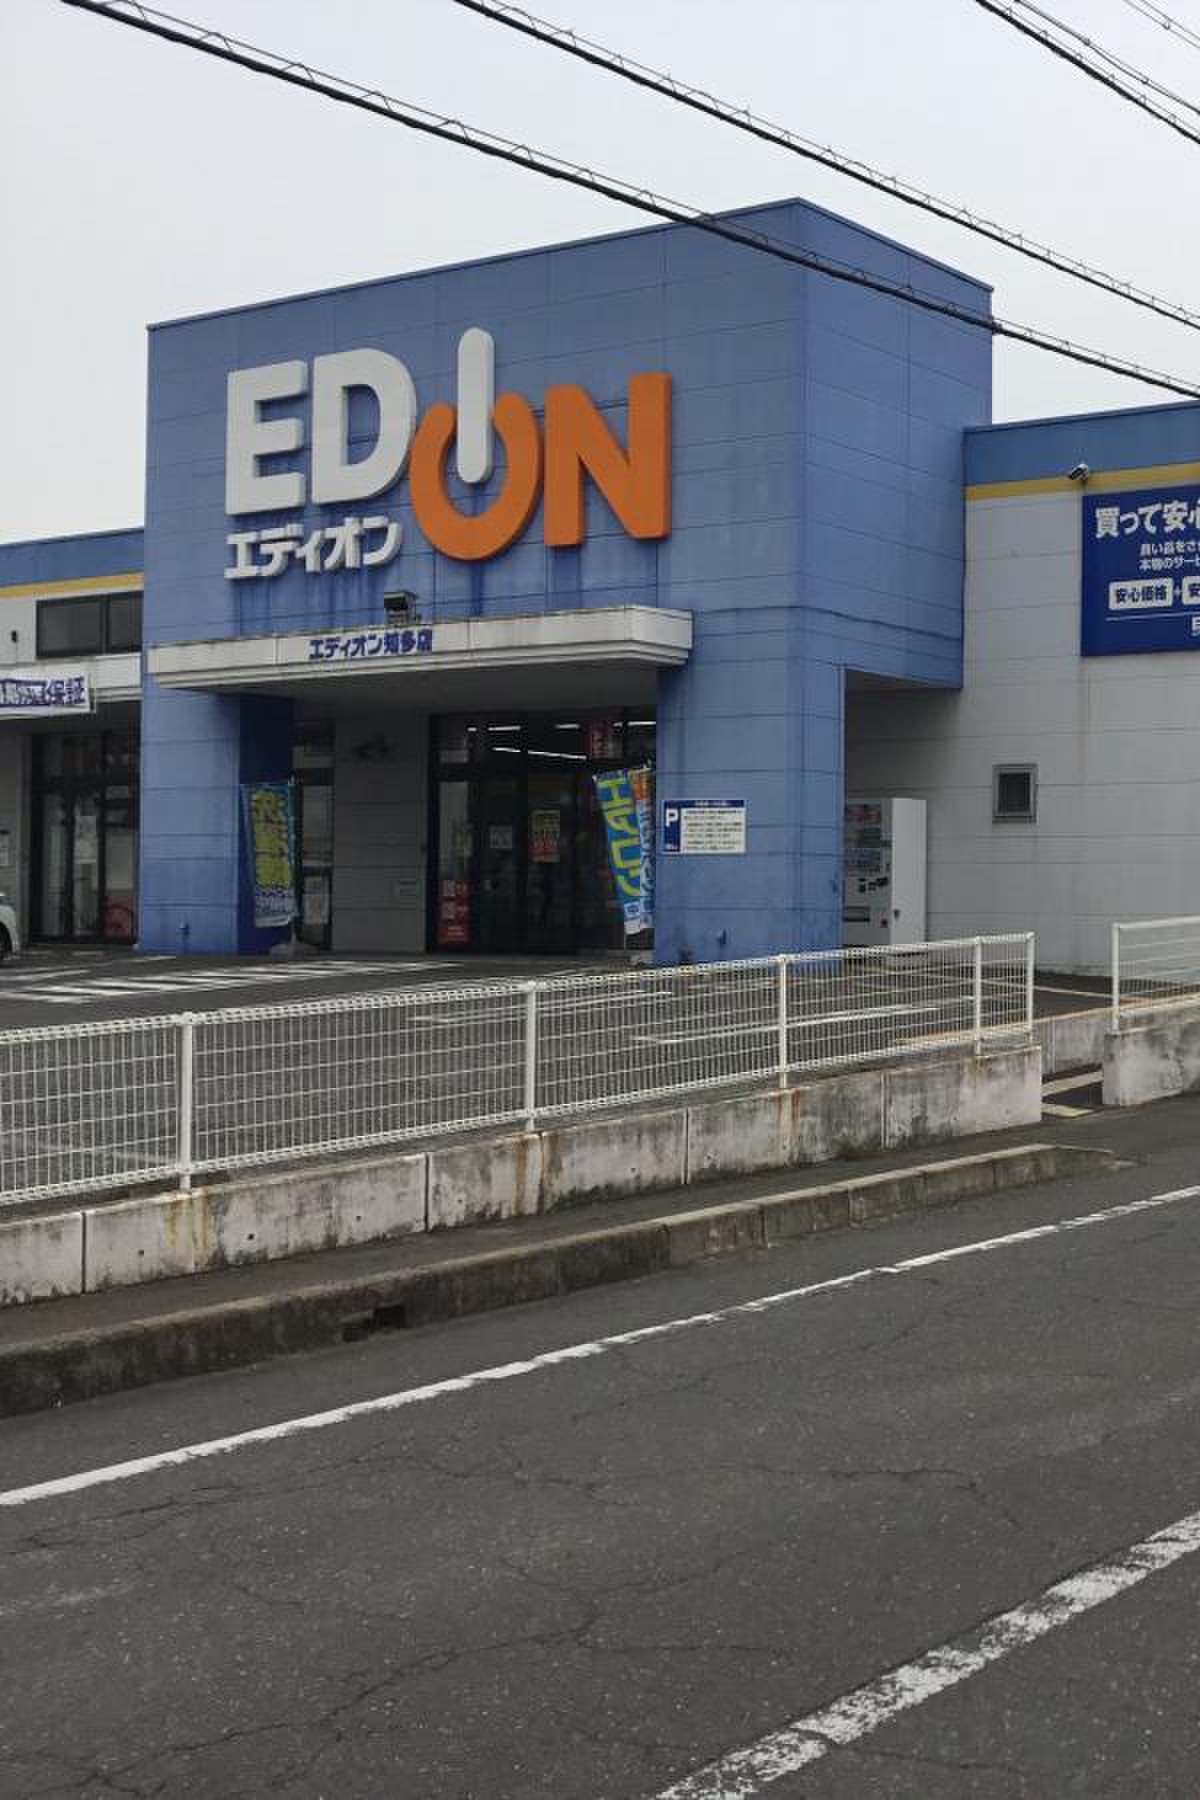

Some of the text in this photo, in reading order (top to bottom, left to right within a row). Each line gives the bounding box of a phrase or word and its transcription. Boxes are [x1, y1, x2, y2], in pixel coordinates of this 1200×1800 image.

[225, 327, 673, 560] EDION
[224, 515, 399, 580] エディオン
[1115, 585, 1168, 603] 安心価格
[309, 628, 432, 660] エディオン知多店
[665, 809, 679, 827] P
